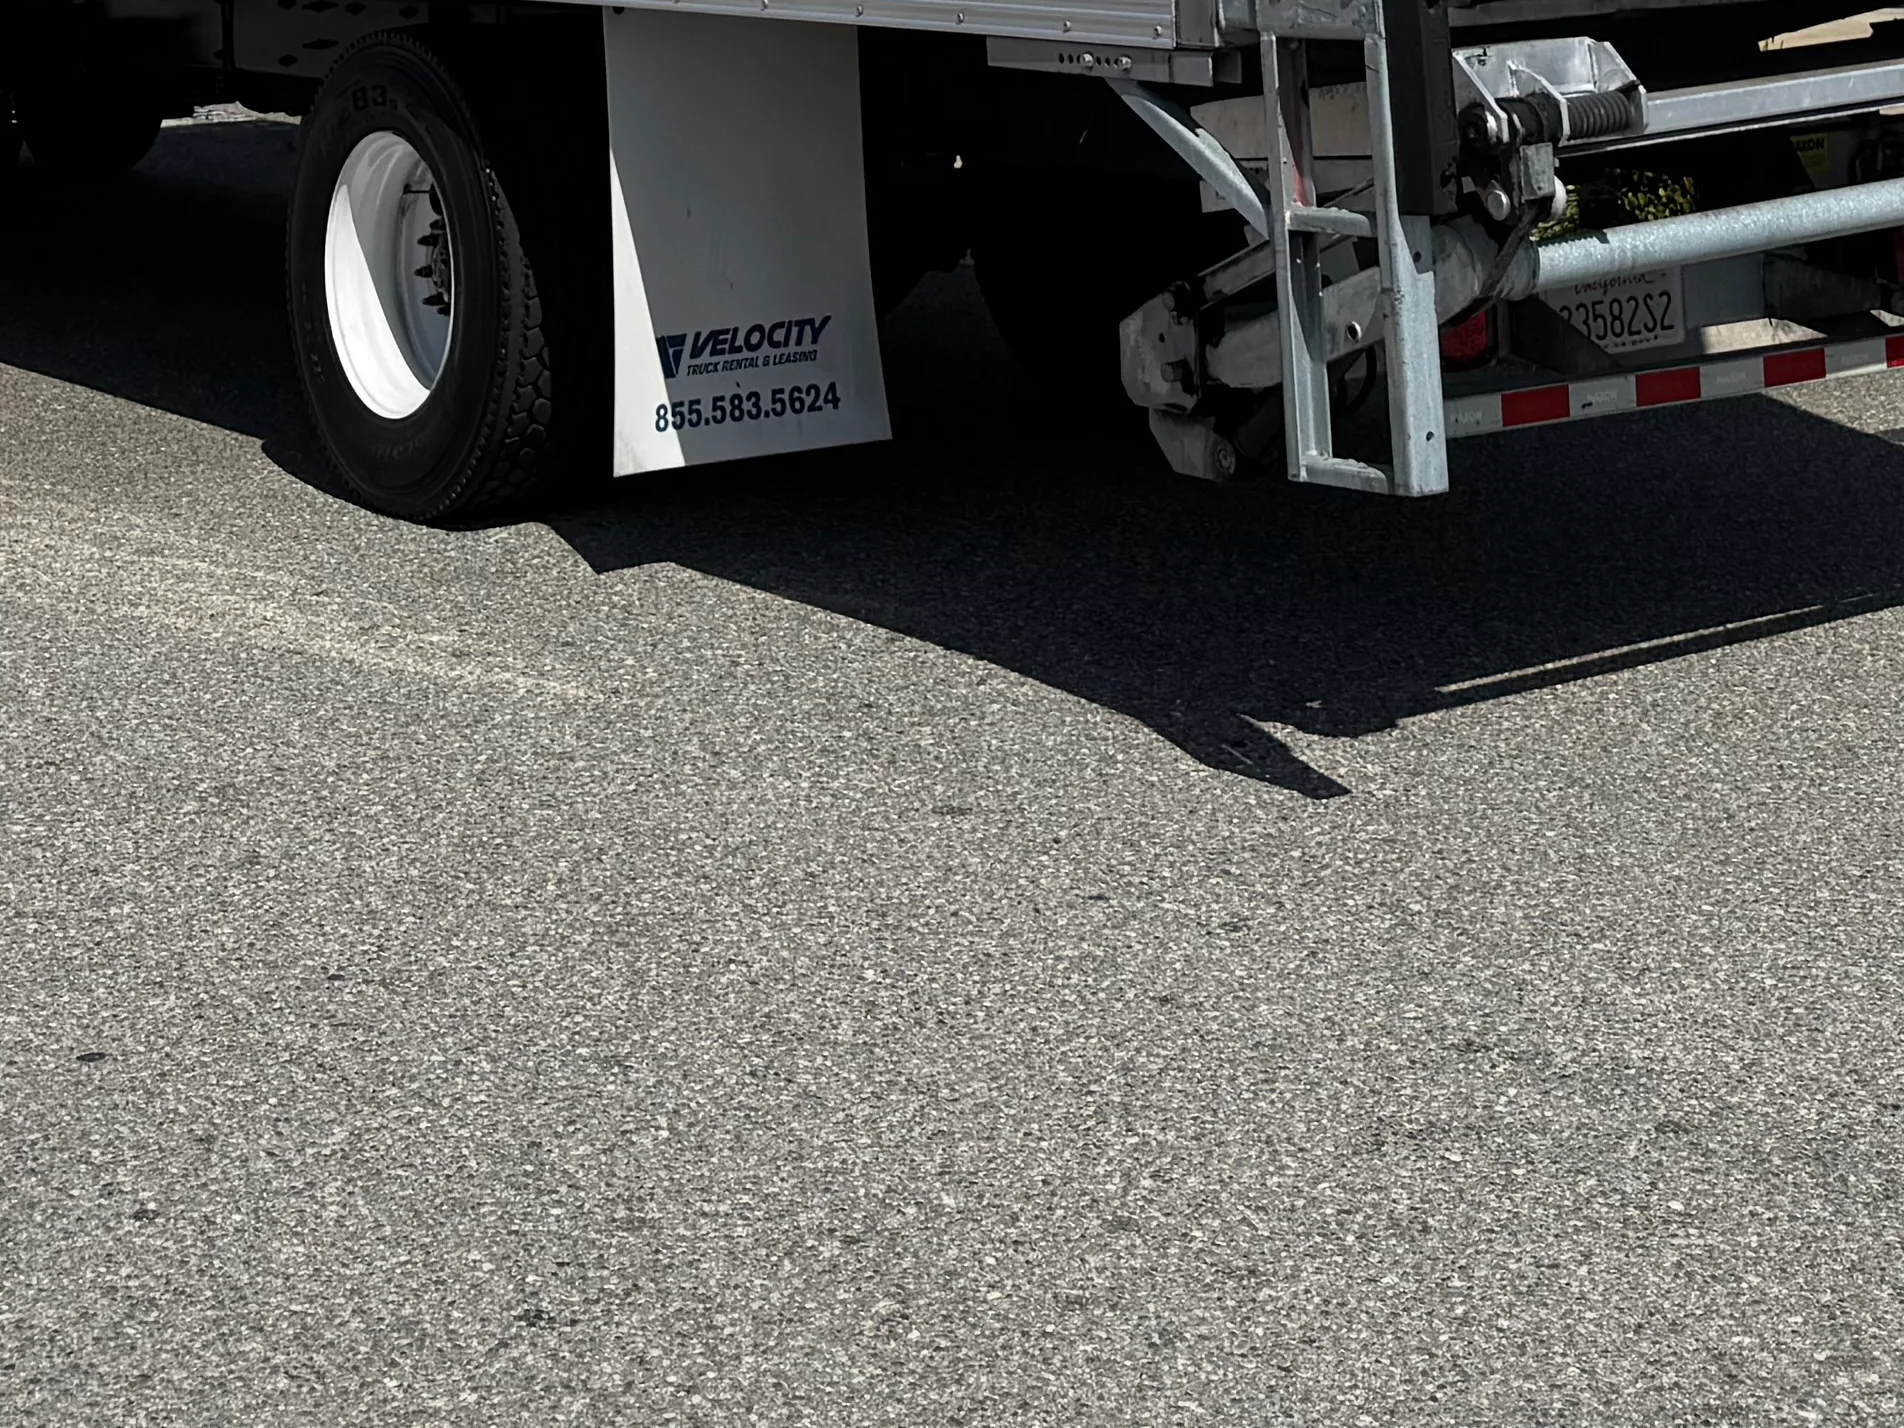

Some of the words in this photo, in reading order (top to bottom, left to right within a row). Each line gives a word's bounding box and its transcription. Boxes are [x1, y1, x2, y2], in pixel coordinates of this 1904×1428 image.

[689, 314, 832, 360] VELOCITY
[686, 361, 721, 377] TRUCK
[721, 355, 760, 373] RENTAL
[772, 349, 818, 366] LEASING
[654, 381, 841, 433] 855.583.5624
